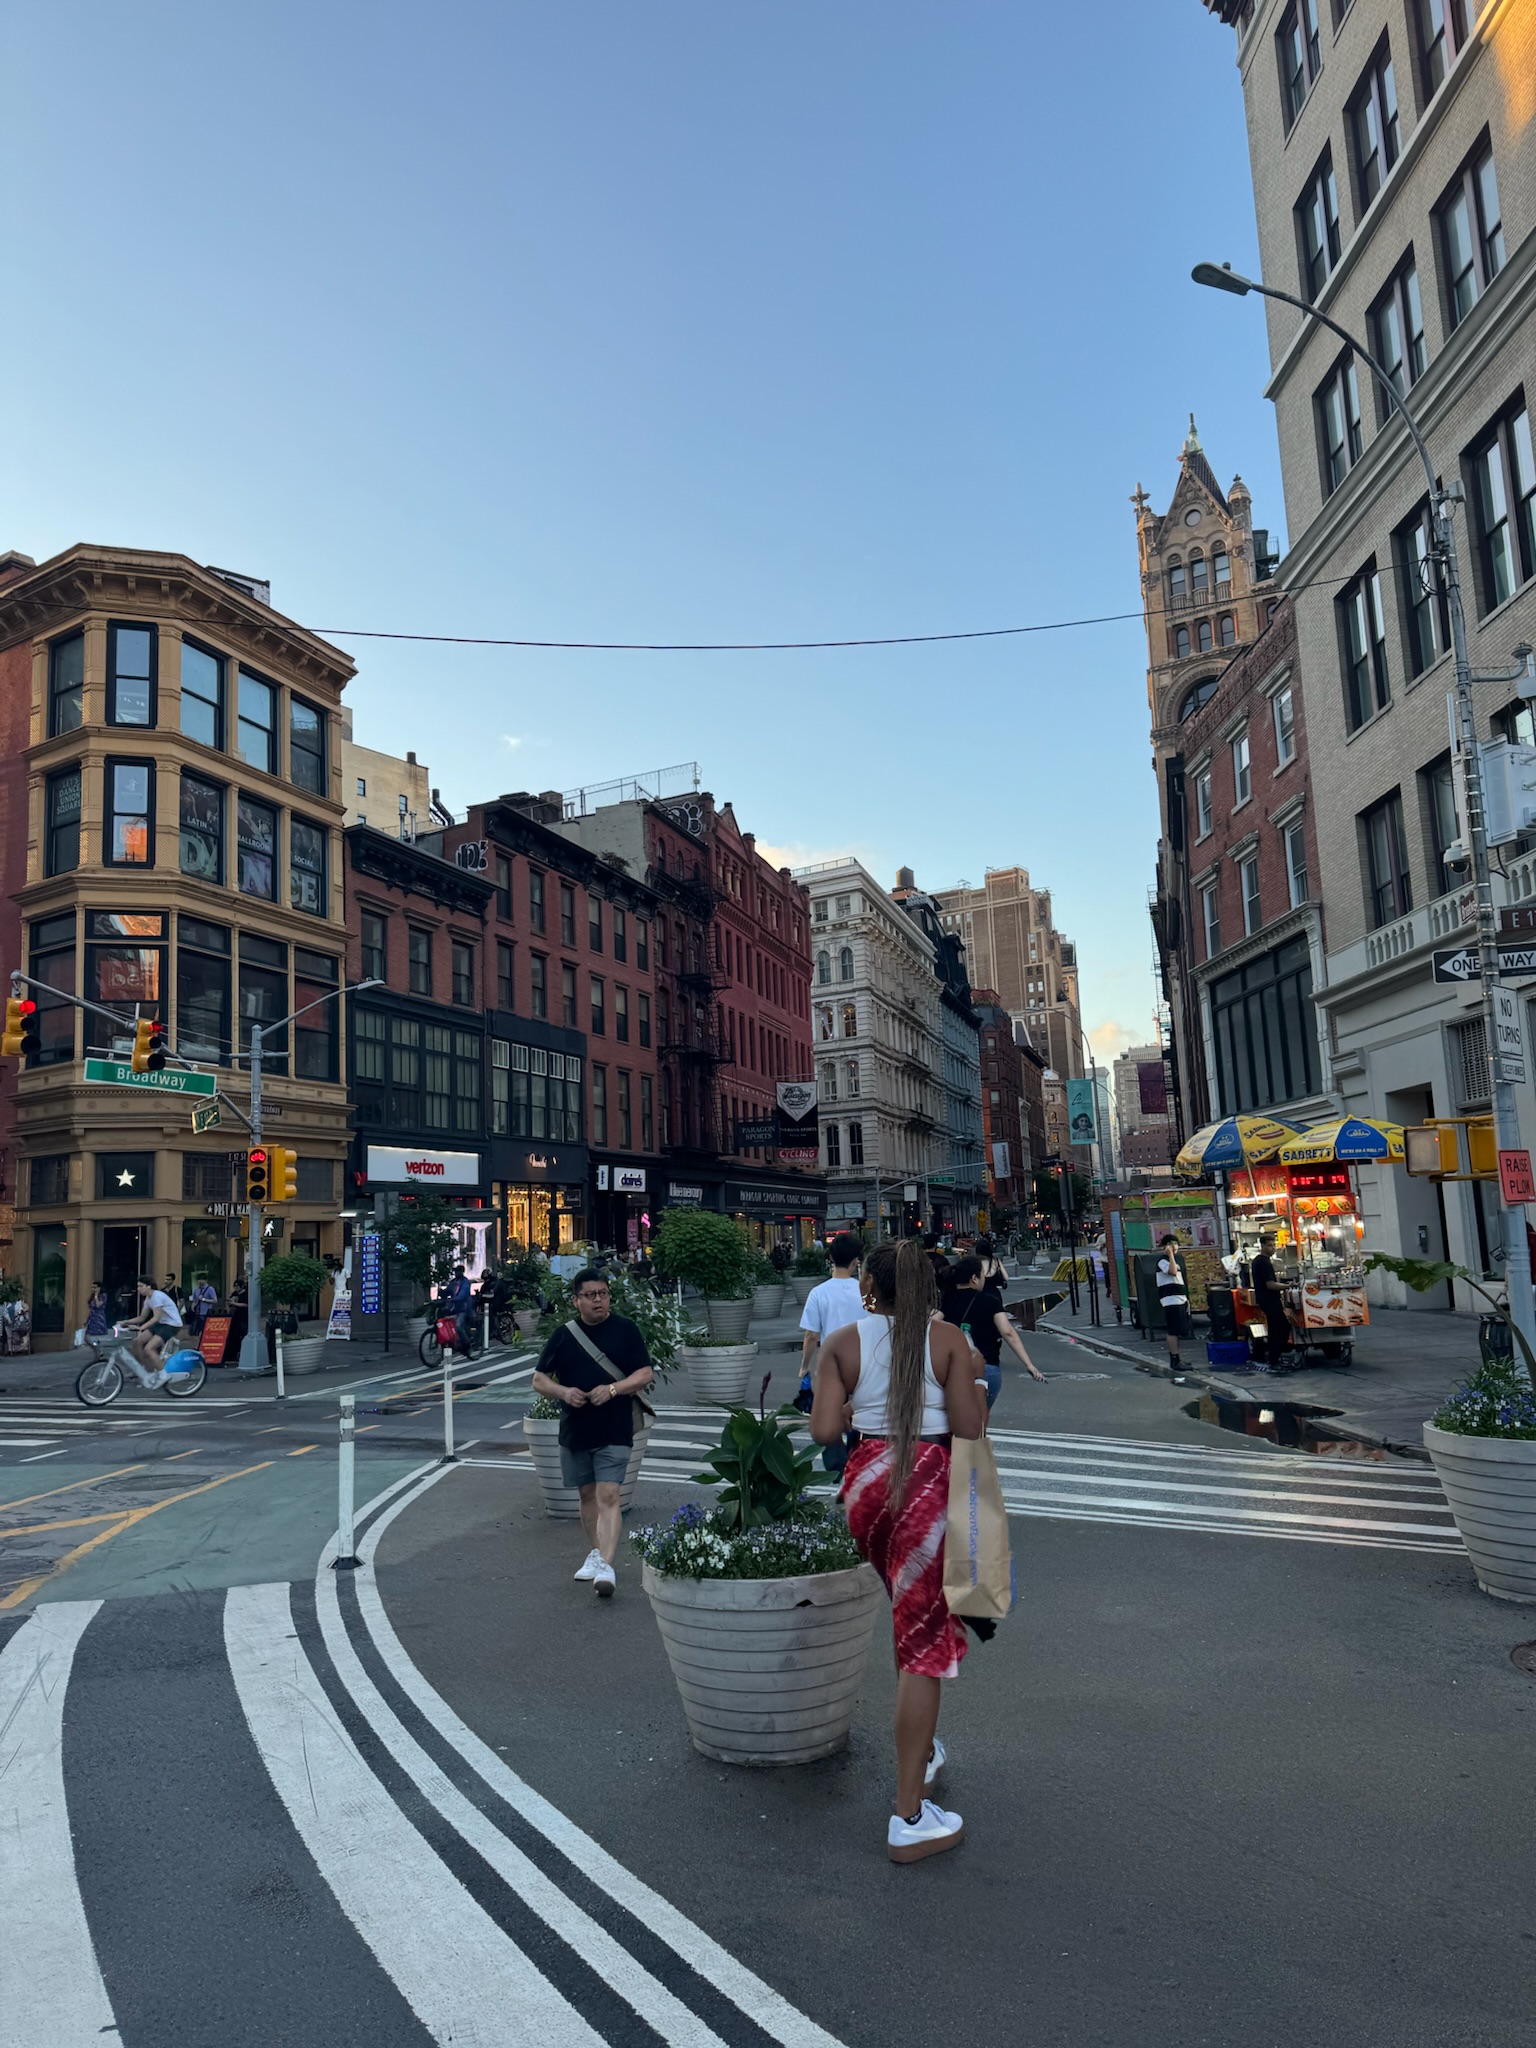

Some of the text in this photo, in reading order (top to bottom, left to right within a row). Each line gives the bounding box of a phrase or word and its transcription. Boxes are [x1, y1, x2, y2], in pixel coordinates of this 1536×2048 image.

[186, 815, 208, 829] LATIN
[238, 834, 271, 850] BALLROOM
[294, 855, 314, 868] SOCIAL
[1512, 910, 1536, 928] E 1
[1452, 952, 1534, 972] ONE WAY
[1500, 997, 1512, 1018] NO
[1497, 1023, 1521, 1045] TURNS
[117, 1067, 186, 1090] Broadway
[1244, 1123, 1276, 1139] SABRETT
[780, 1150, 815, 1158] CYCLING
[1282, 1147, 1332, 1161] SABRETT
[405, 1159, 445, 1175] verizon
[1506, 1158, 1528, 1173] RAISE
[1510, 1180, 1531, 1194] PLOW
[740, 1190, 761, 1202] PARAGON
